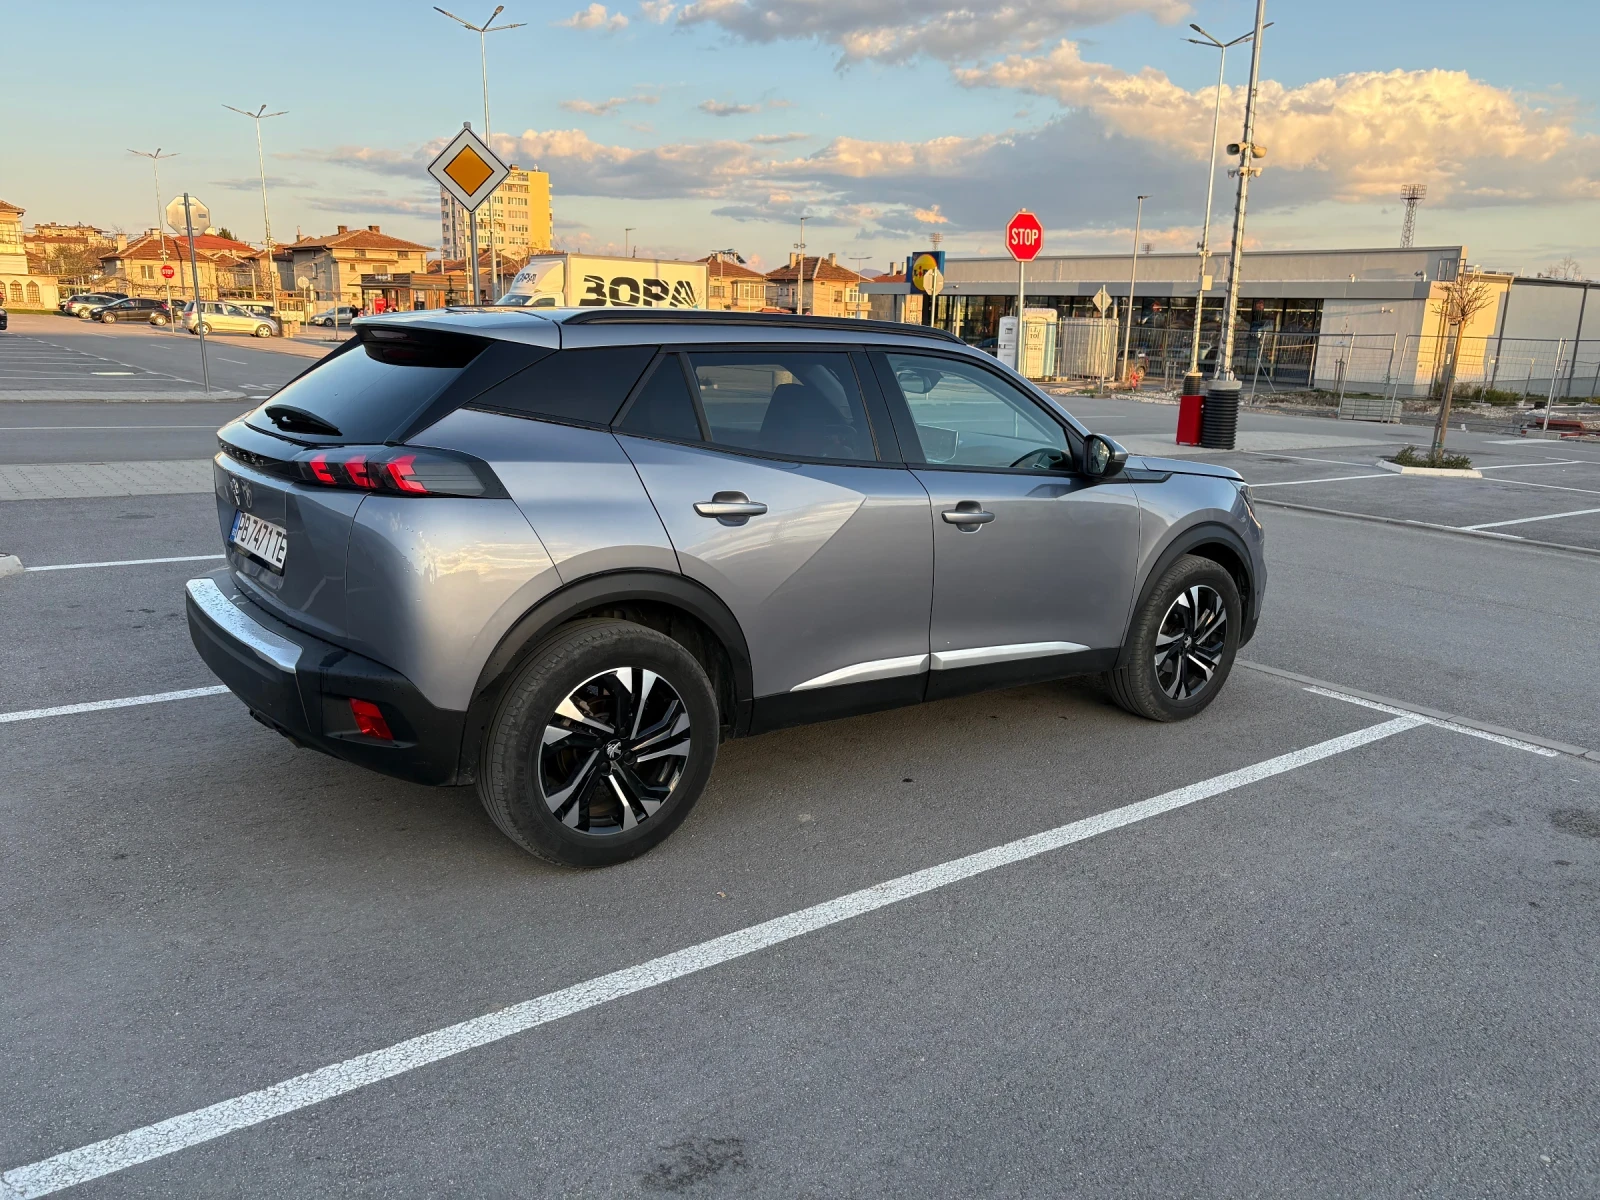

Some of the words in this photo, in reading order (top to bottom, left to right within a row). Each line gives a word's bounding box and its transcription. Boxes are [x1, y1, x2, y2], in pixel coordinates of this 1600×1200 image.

[1011, 228, 1039, 246] STOP
[579, 275, 697, 308] ЗОРА
[247, 518, 274, 556] 7471
[271, 529, 288, 564] TE
